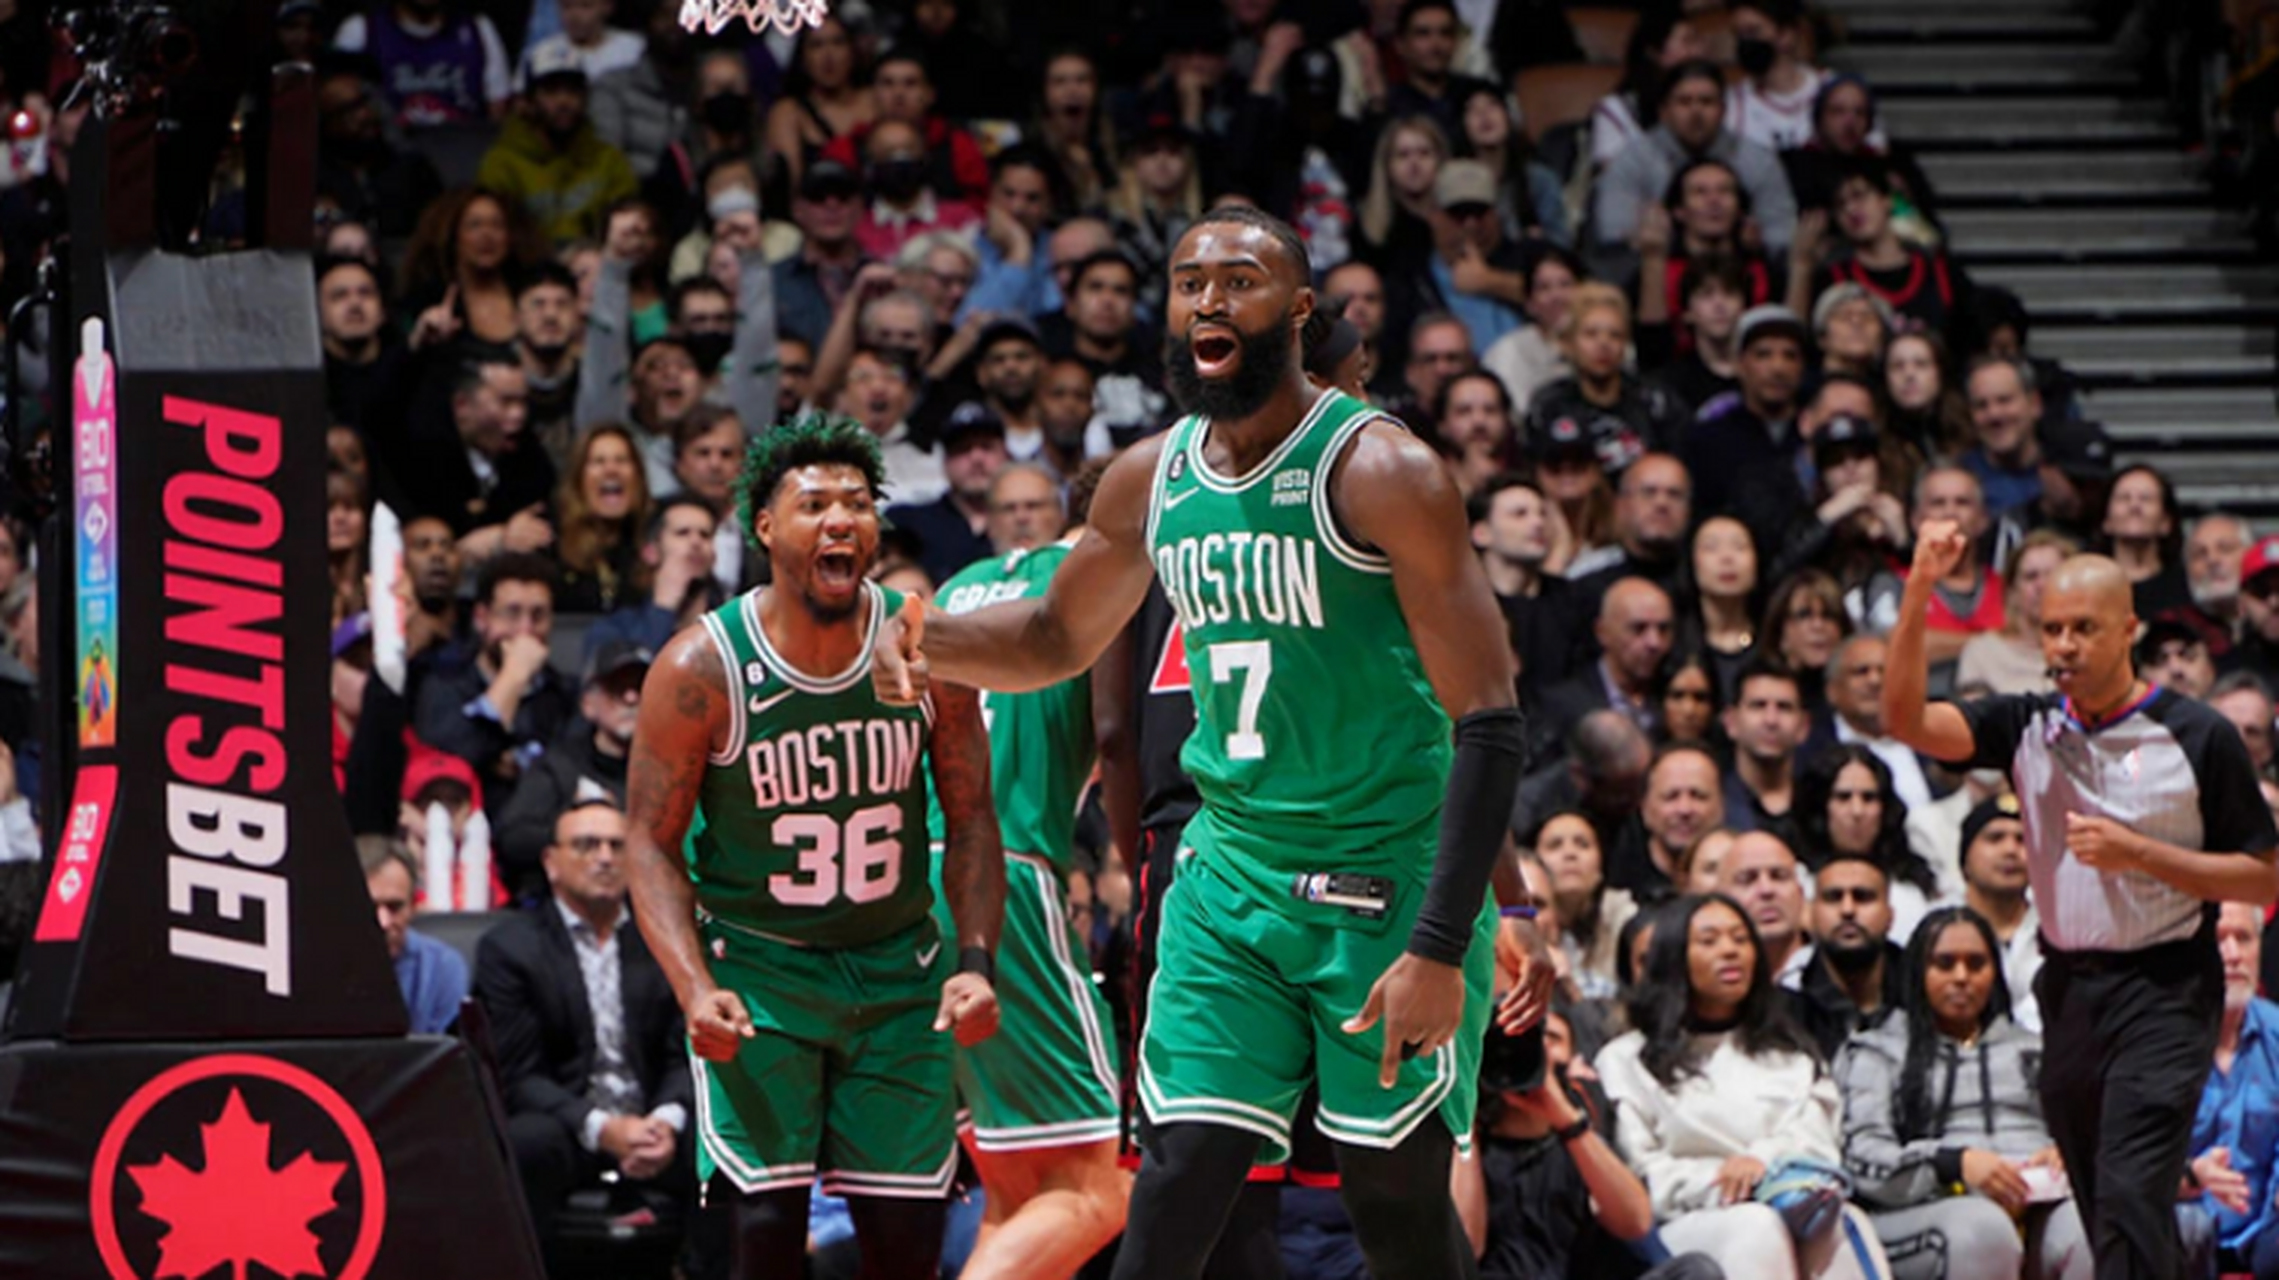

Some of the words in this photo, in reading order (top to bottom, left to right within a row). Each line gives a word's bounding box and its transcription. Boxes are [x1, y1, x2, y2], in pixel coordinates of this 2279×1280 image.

[1157, 532, 1324, 634] BOSTON
[162, 394, 290, 998] POINTSBET
[1208, 638, 1272, 760] 7
[747, 718, 921, 809] BOSTON
[768, 802, 904, 906] 36
